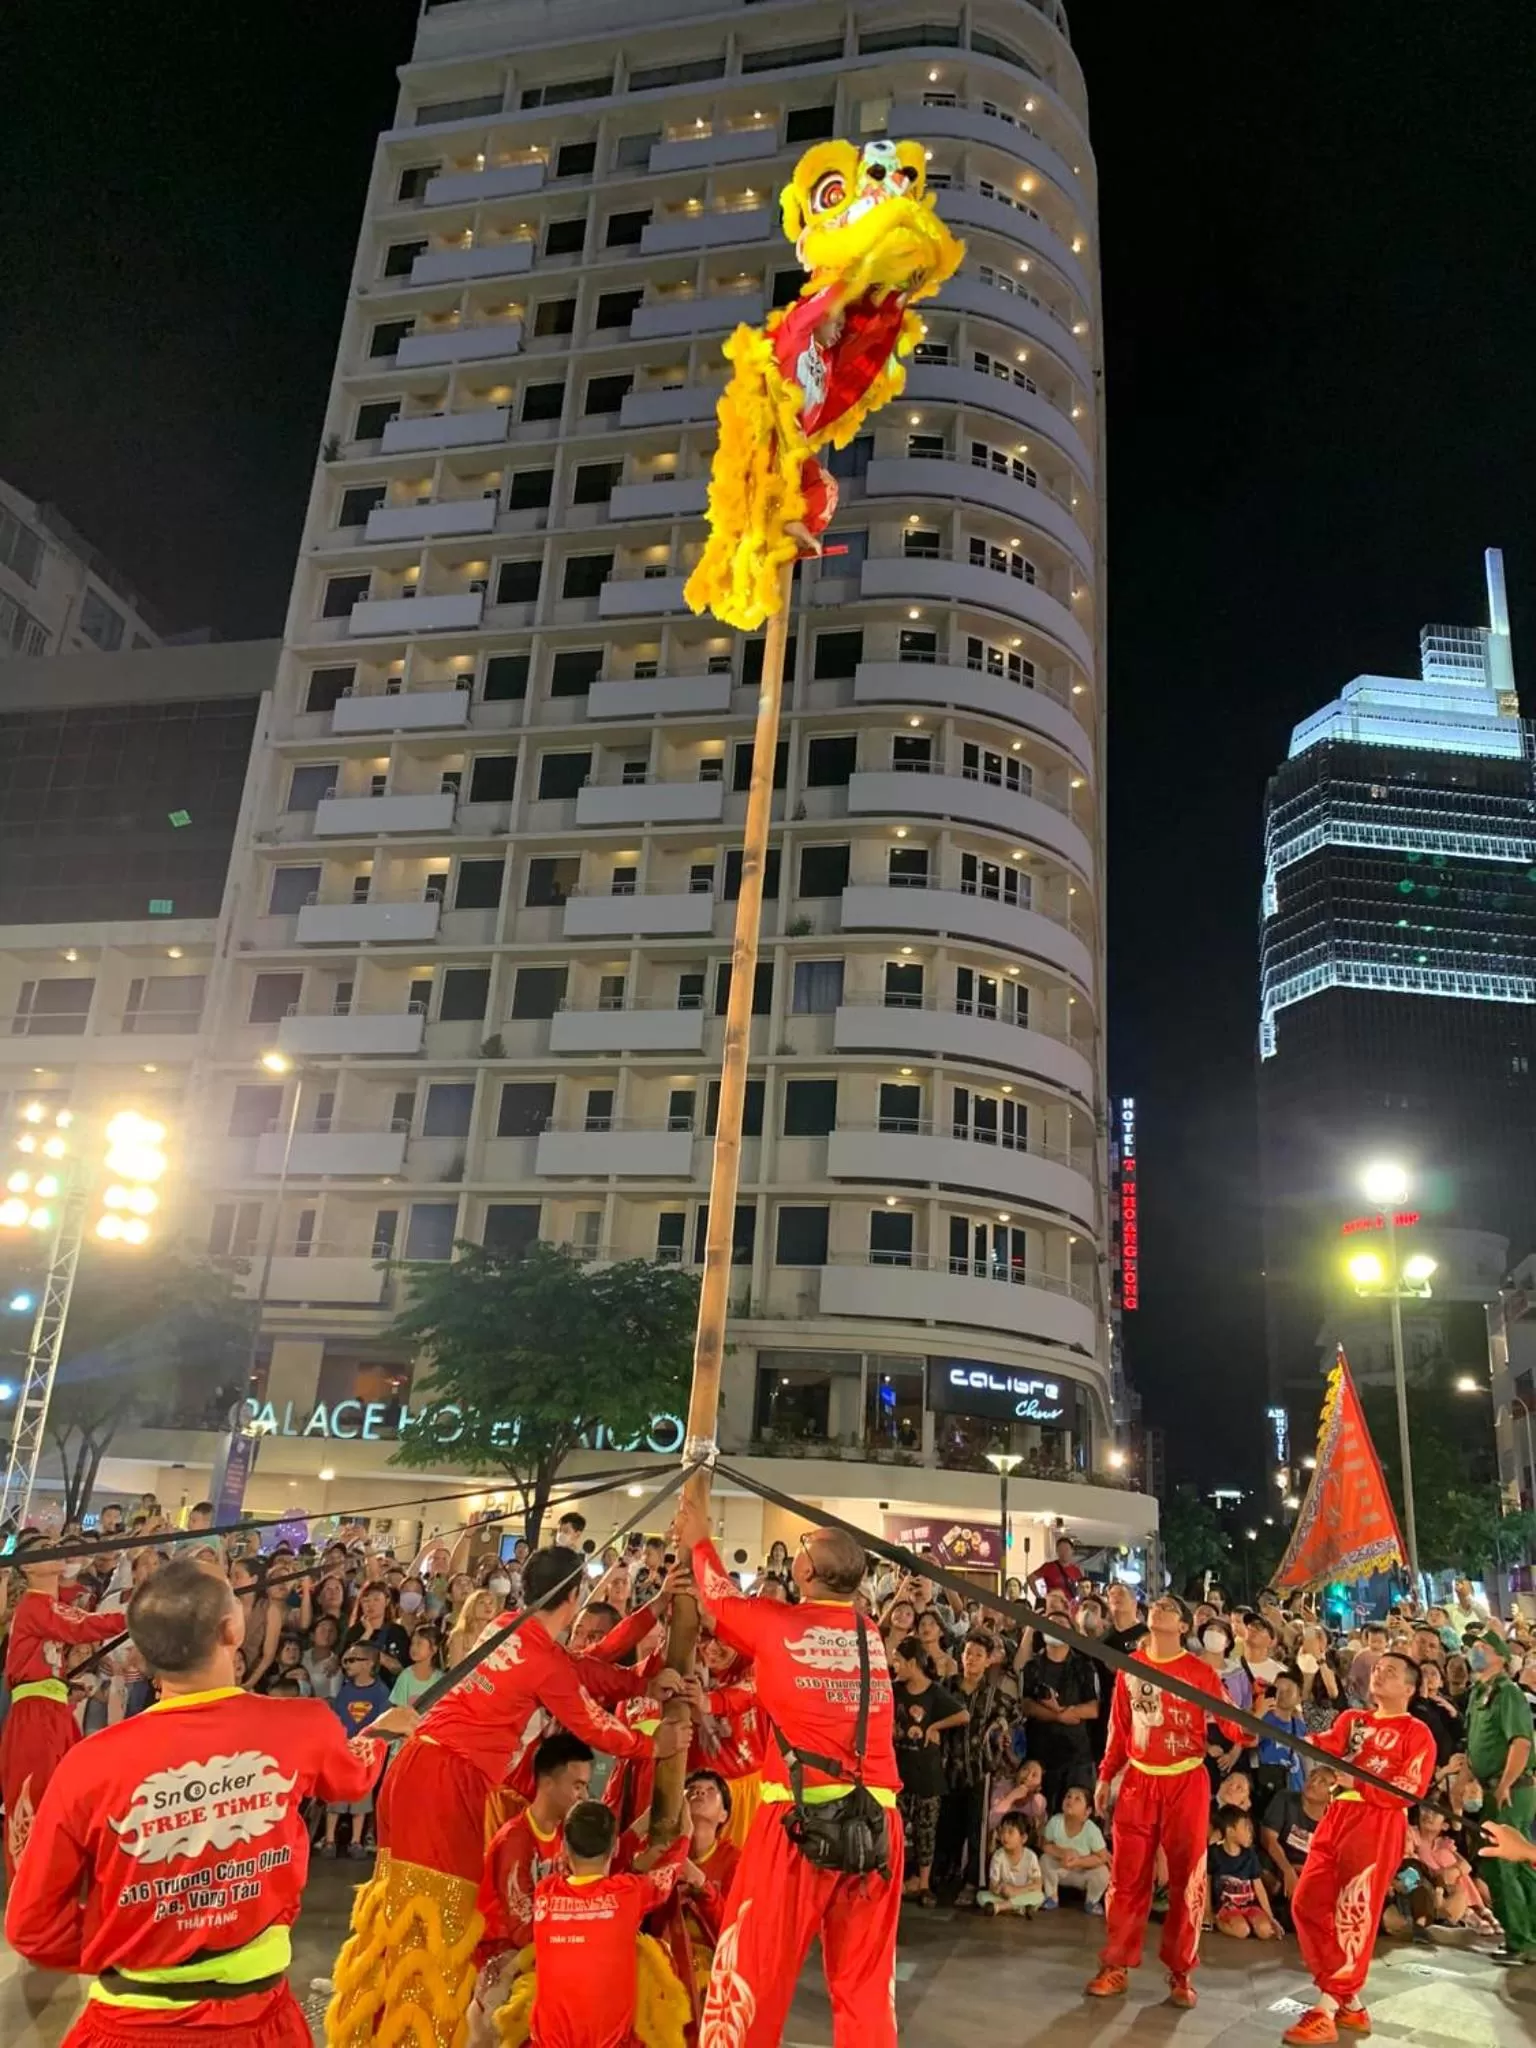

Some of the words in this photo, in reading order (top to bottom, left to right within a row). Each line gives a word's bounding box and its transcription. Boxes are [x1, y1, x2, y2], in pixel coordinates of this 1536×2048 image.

[1122, 1098, 1134, 1156] HOTEL
[1276, 1418, 1285, 1461] HOTEL
[140, 1806, 207, 1838] FREE
